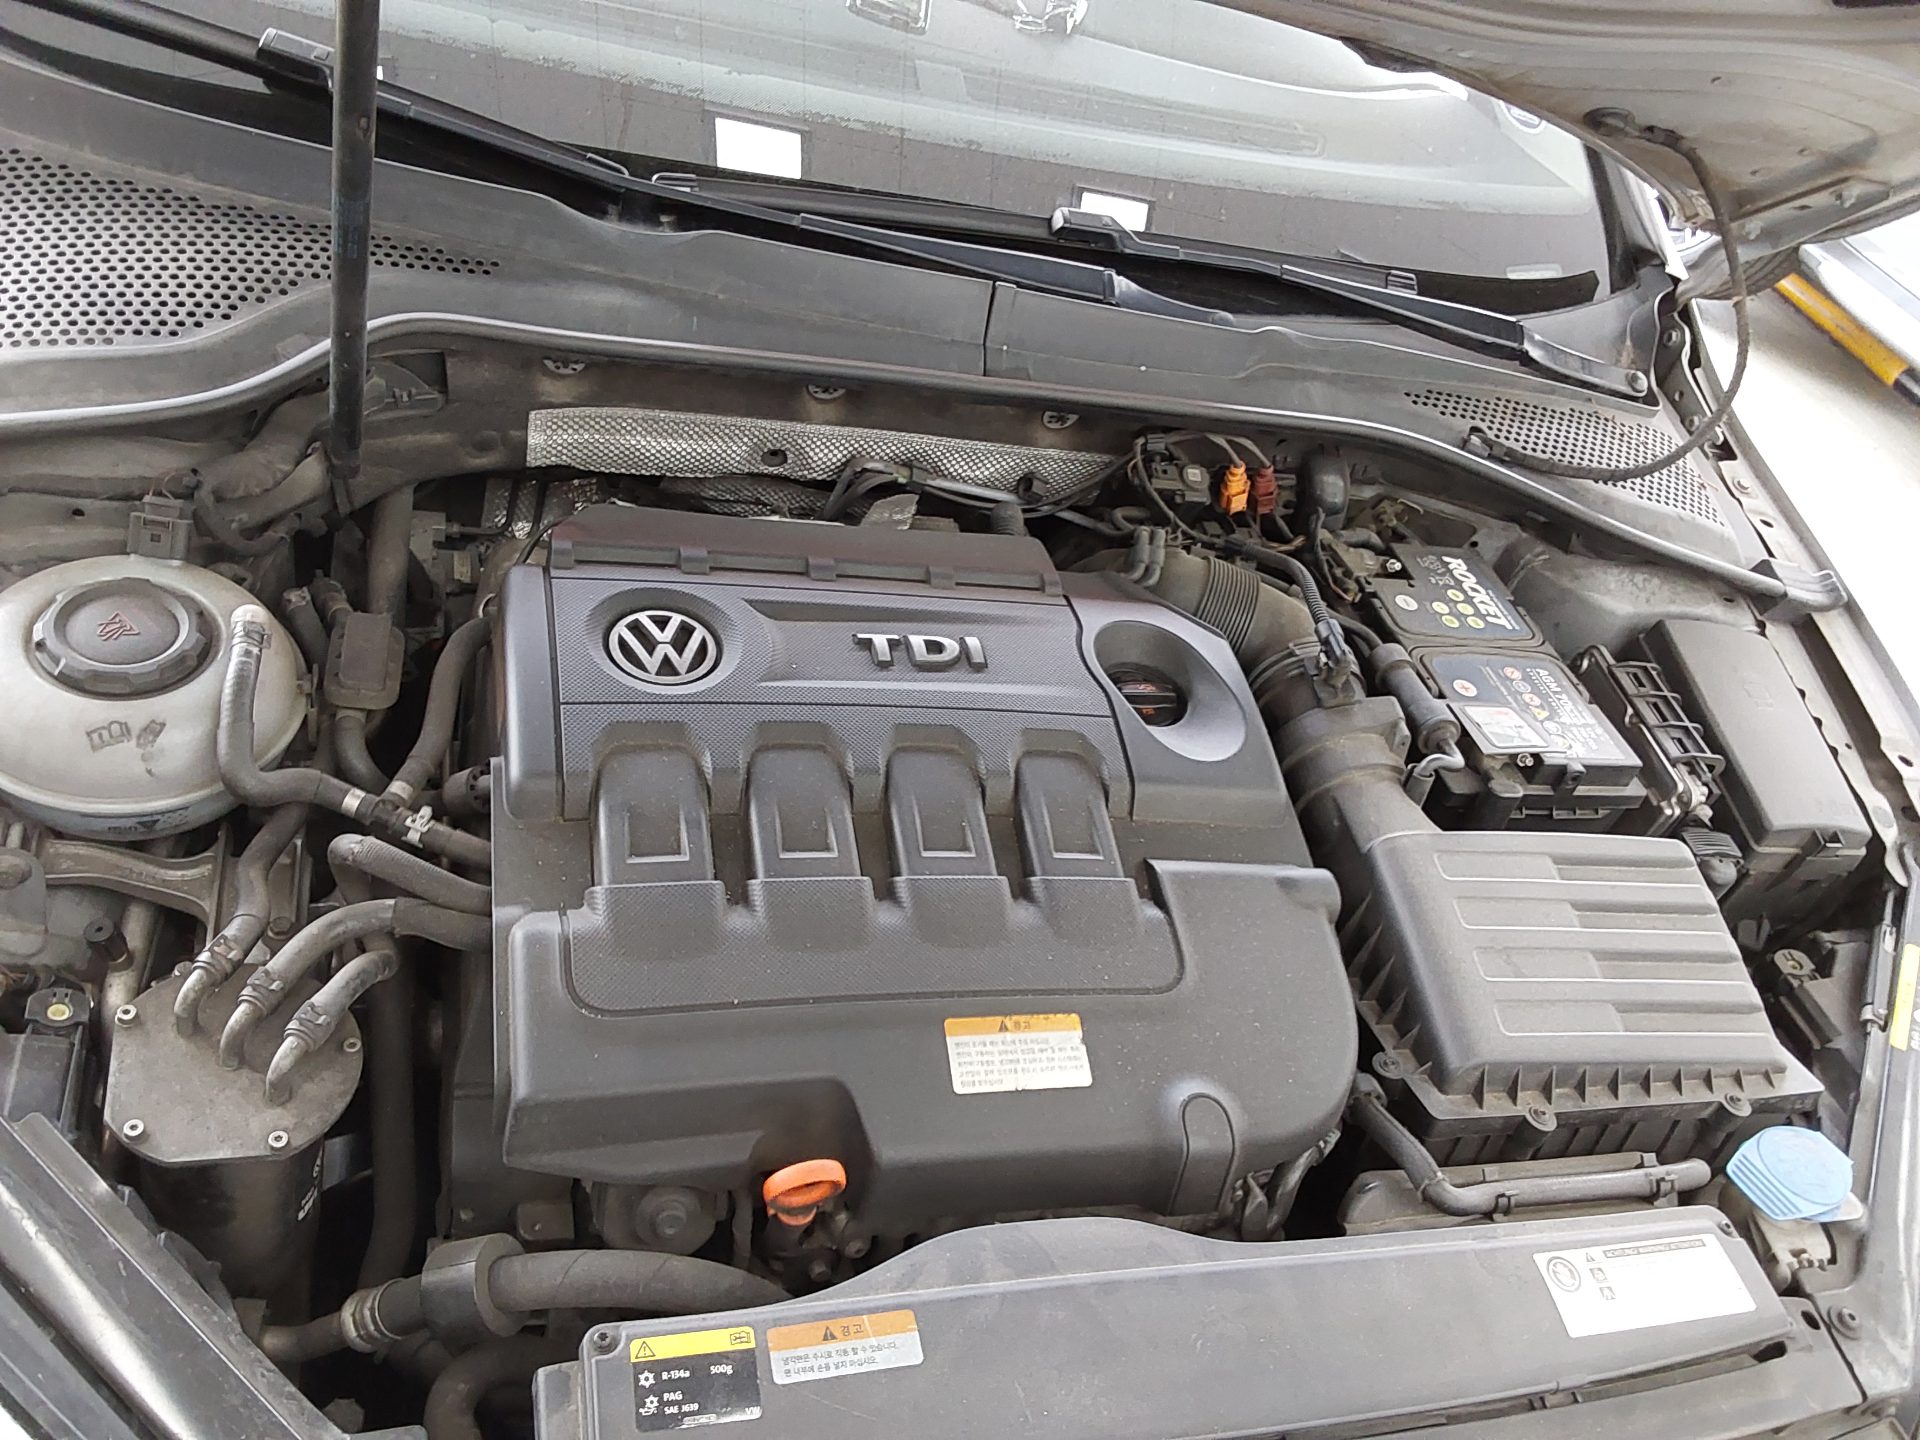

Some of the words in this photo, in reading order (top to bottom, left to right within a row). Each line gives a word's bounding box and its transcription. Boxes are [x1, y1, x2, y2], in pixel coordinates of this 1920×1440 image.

[1441, 554, 1513, 631] ROCKET
[609, 610, 717, 684] VW
[852, 633, 988, 670] TDI
[1535, 668, 1562, 692] AGM
[840, 1323, 864, 1337] 경고
[860, 1345, 868, 1354] 수
[661, 1369, 691, 1380] R-134a
[710, 1364, 734, 1376] 500g
[663, 1390, 684, 1402] PAG
[664, 1405, 680, 1415] SAE
[681, 1402, 700, 1413] J639
